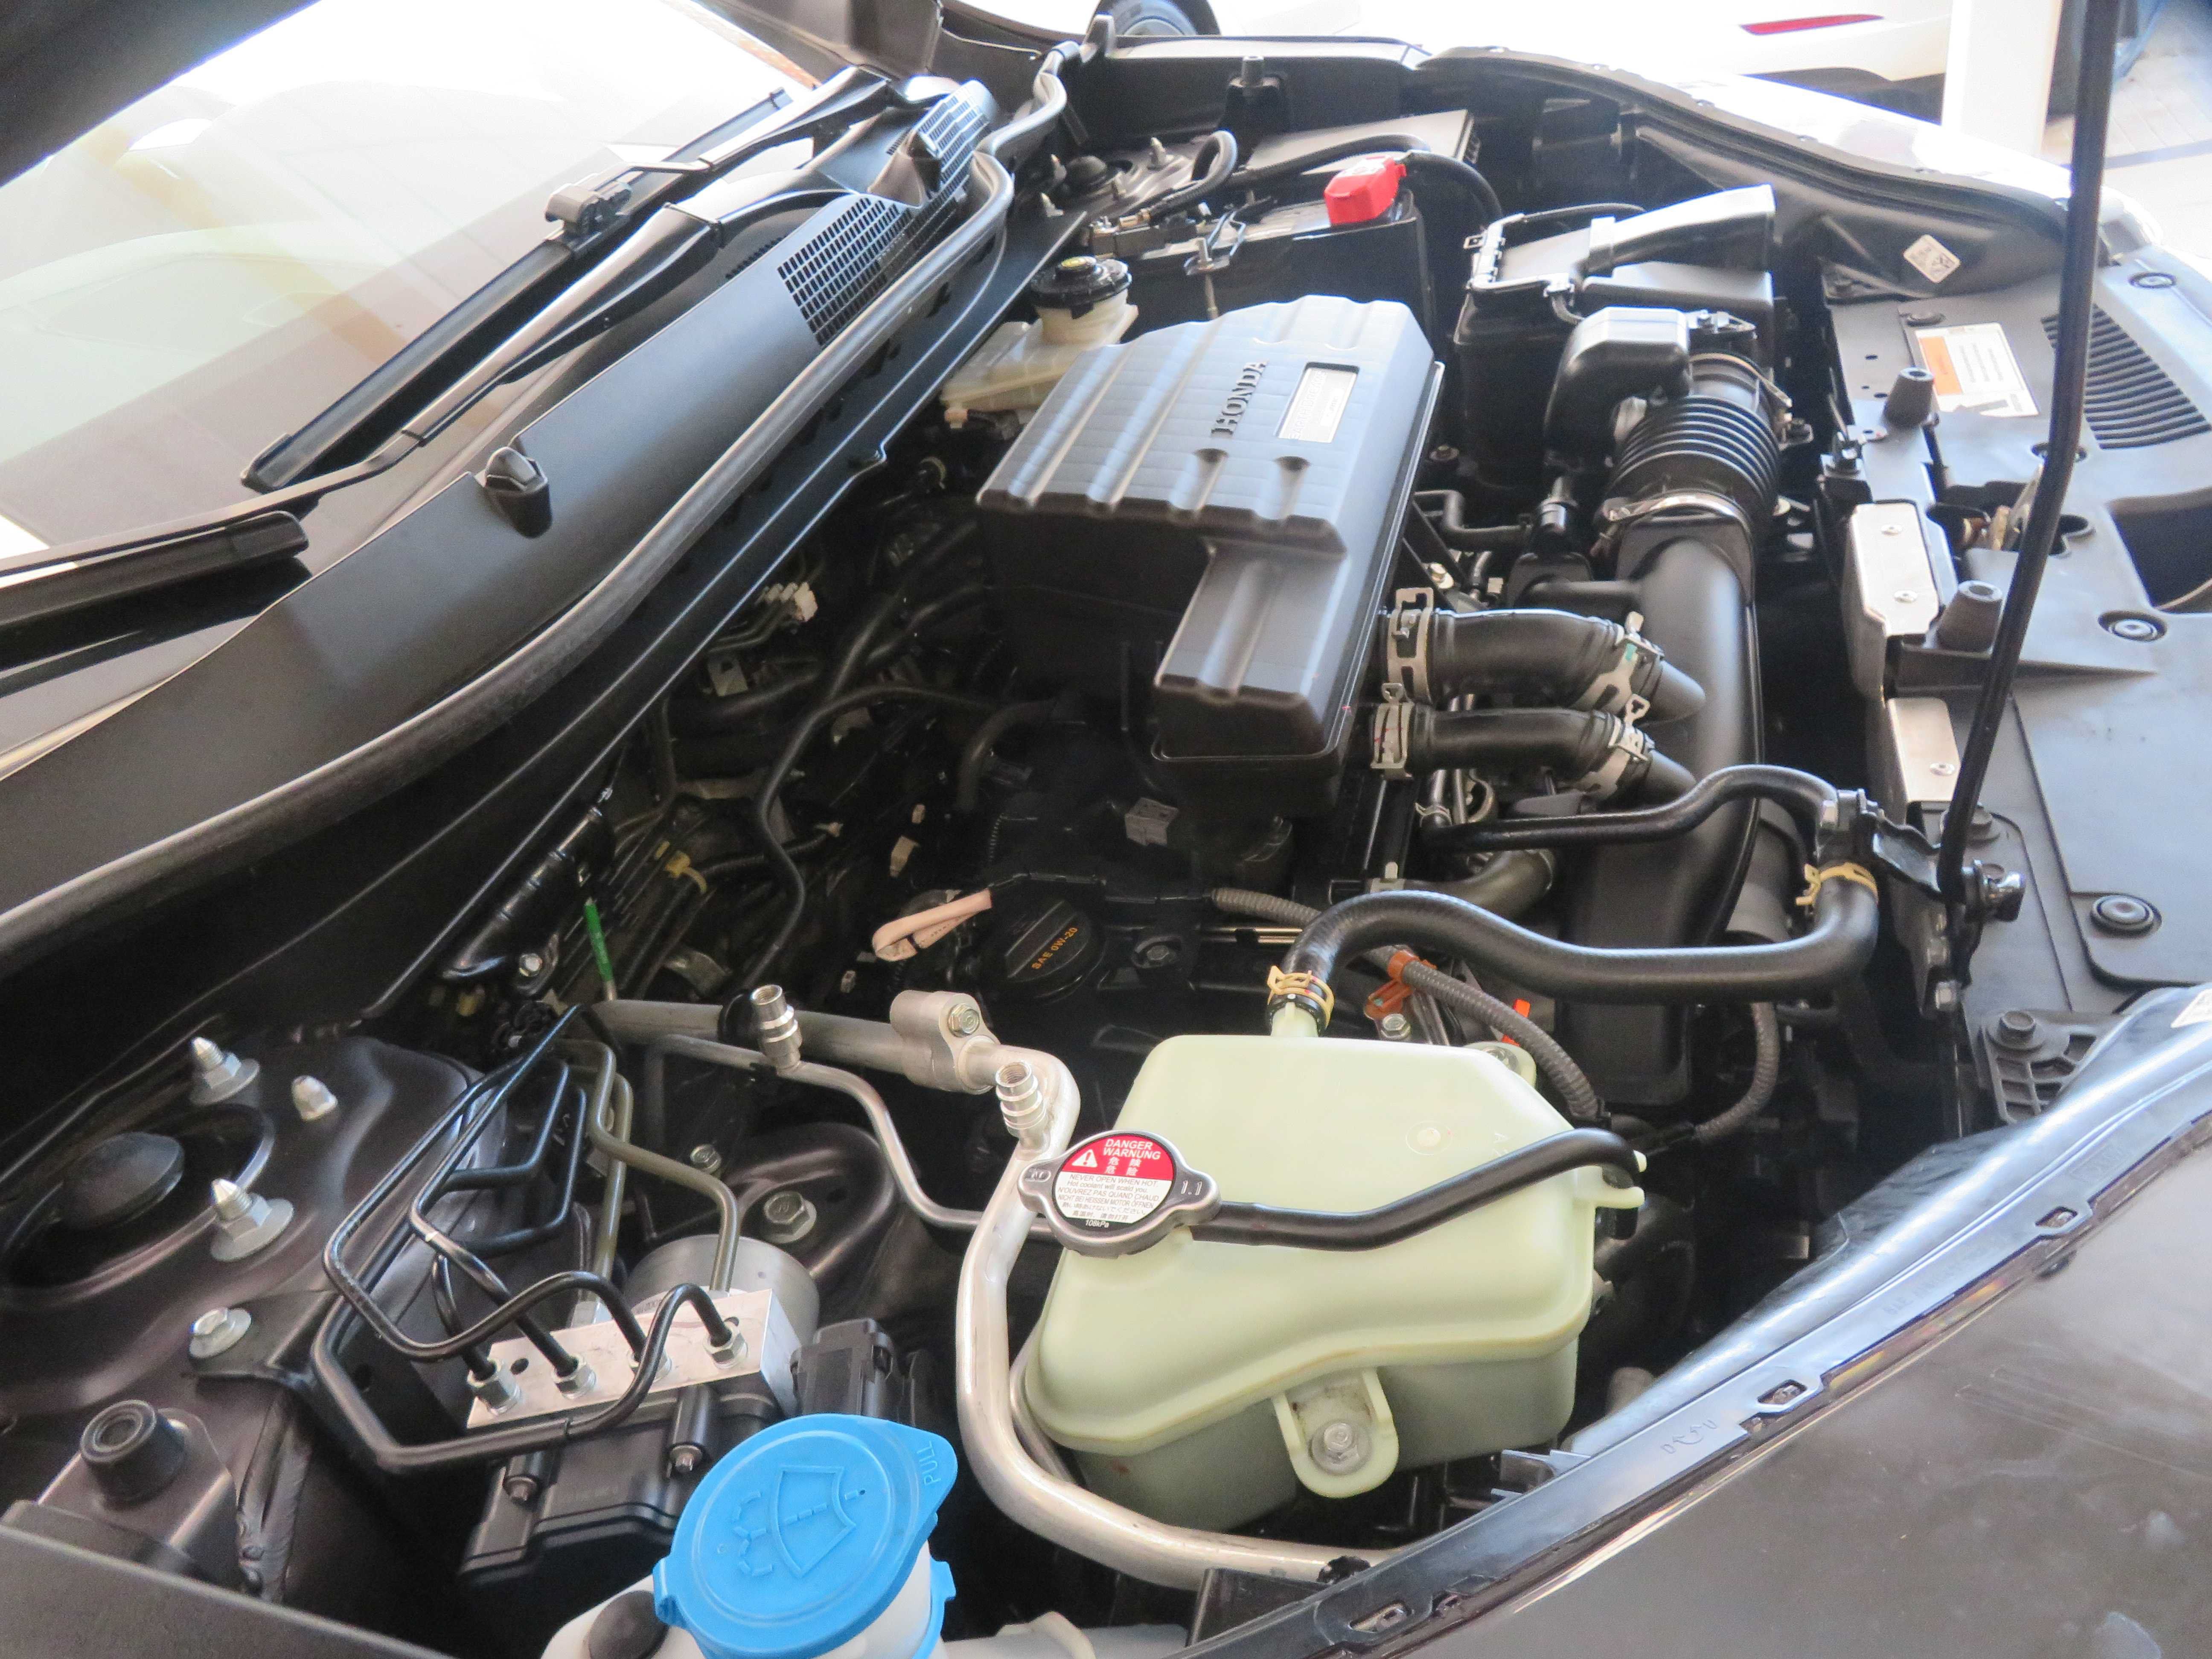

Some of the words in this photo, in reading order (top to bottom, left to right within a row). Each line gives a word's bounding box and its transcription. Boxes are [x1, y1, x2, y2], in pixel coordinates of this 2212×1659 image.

[1210, 360, 1268, 437] HONDA
[1031, 952, 1053, 969] SAE
[1051, 928, 1078, 951] 0W-20
[1106, 1139, 1153, 1150] DANGER
[1103, 1147, 1161, 1160] WARNUNG
[1058, 1187, 1092, 1195] N'OUVREZ
[1109, 1191, 1133, 1199] QUAND
[1181, 1180, 1202, 1196] 1.1
[1085, 1220, 1109, 1228] 108kPa
[917, 1441, 941, 1485] PULL
